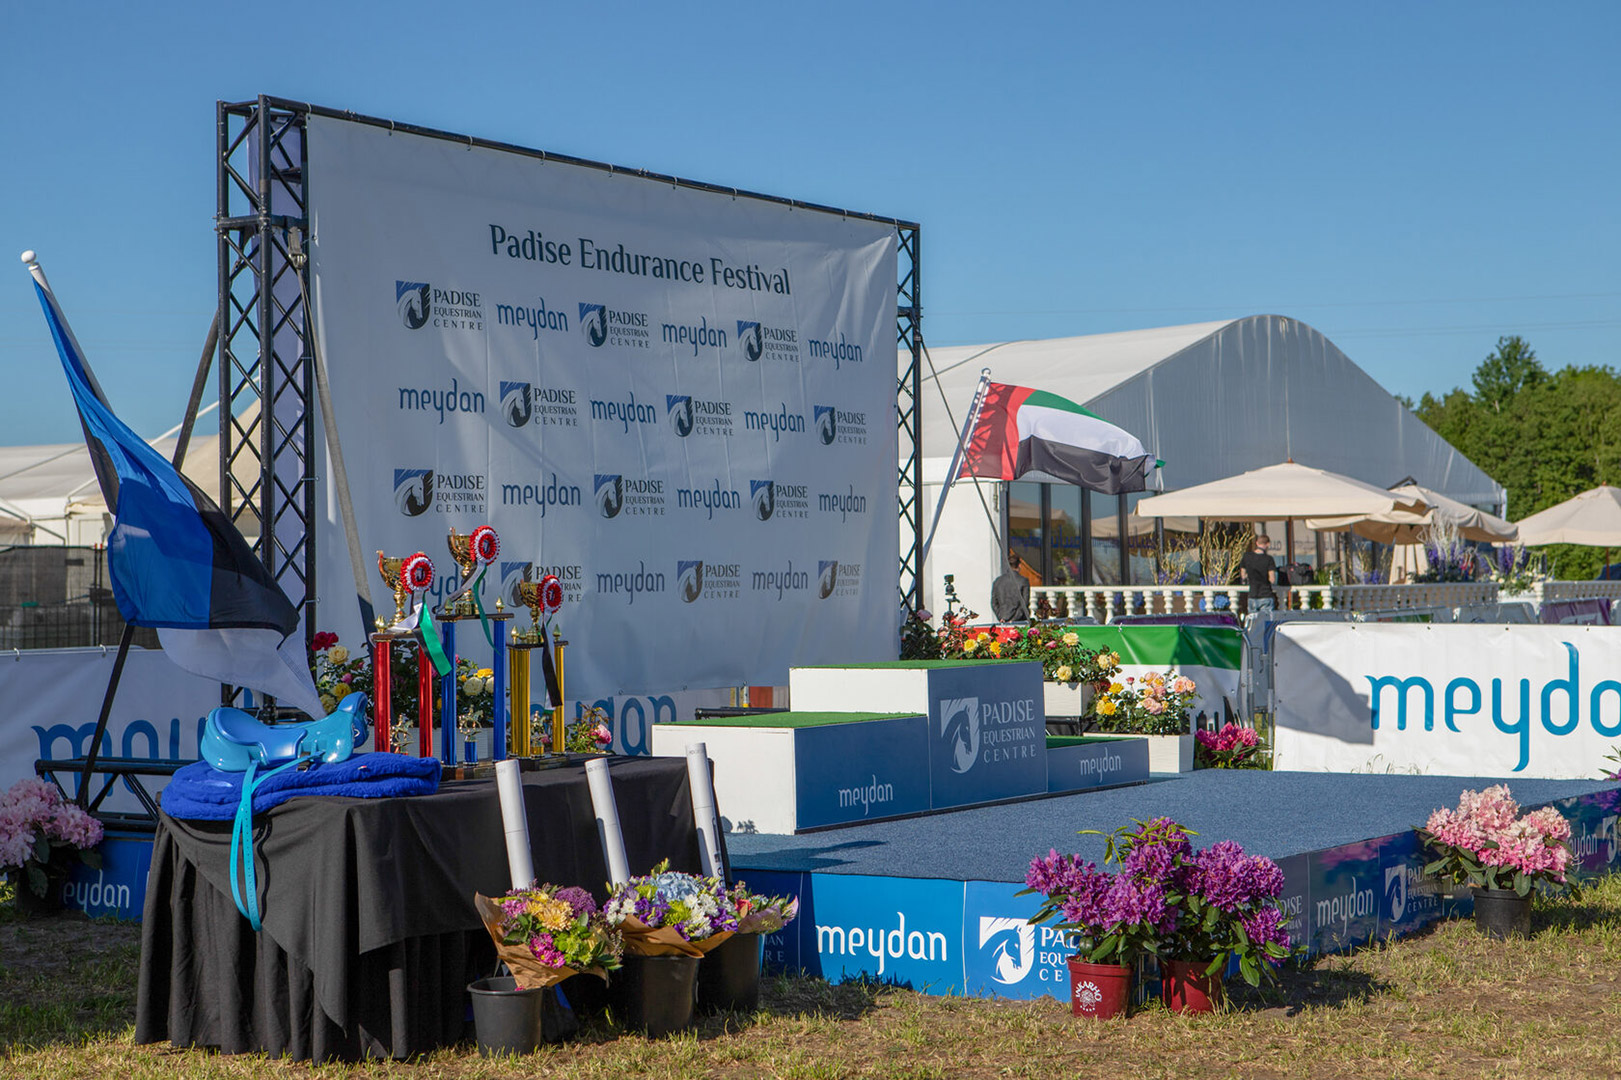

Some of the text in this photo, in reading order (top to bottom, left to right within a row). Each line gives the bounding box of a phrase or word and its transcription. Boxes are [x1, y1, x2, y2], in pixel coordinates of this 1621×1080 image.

[489, 224, 790, 295] Padise Endurance Festival
[433, 289, 481, 307] PADISE
[433, 307, 482, 319] EQUESTRIAN
[496, 297, 569, 340] meydan
[609, 310, 648, 327] PADISE
[433, 319, 483, 331] CENTRE
[610, 327, 649, 338] EQUESTRIAN
[661, 316, 727, 357] meydan
[763, 327, 797, 343] PADISE
[611, 338, 650, 349] CENTRE
[764, 342, 799, 352] EQUESTRIAN
[808, 332, 863, 370] meydan
[765, 352, 800, 363] CENTRE
[399, 378, 485, 425] meydan
[533, 387, 576, 404] PADISE
[534, 405, 577, 415] EQUESTRIAN
[590, 391, 656, 434] meydan
[694, 400, 732, 415] PADISE
[535, 416, 578, 427] CENTRE
[695, 416, 733, 426] EQUESTRIAN
[744, 402, 805, 442] meydan
[837, 411, 866, 425] PADISE
[696, 427, 734, 437] CENTRE
[838, 436, 867, 445] CENTRE
[437, 475, 485, 490] PADISE
[625, 479, 664, 494] PADISE
[436, 492, 484, 502] EQUESTRIAN
[501, 473, 581, 518] meydan
[677, 478, 741, 520] meydan
[776, 485, 808, 498] PADISE
[436, 503, 485, 514] CENTRE
[625, 496, 665, 505] EQUESTRIAN
[776, 499, 809, 508] EQUESTRIAN
[818, 484, 866, 524] meydan
[625, 506, 665, 516] CENTRE
[776, 509, 809, 519] CENTRE
[705, 564, 740, 578] PADISE
[596, 561, 665, 605] meydan
[704, 579, 740, 589] EQUESTRIAN
[752, 560, 809, 602] meydan
[704, 590, 740, 600] CENTRE
[982, 698, 1035, 727] PADISE
[1364, 641, 1621, 772] meyda
[983, 727, 1035, 745] EQUESTRIAN
[983, 744, 1036, 764] CENTRE
[1079, 746, 1122, 784] meydan
[838, 774, 894, 816] meydan
[63, 869, 130, 915] eydan
[1316, 876, 1374, 937] meydan
[1407, 896, 1438, 914] CENTRE
[816, 911, 948, 976] meydan
